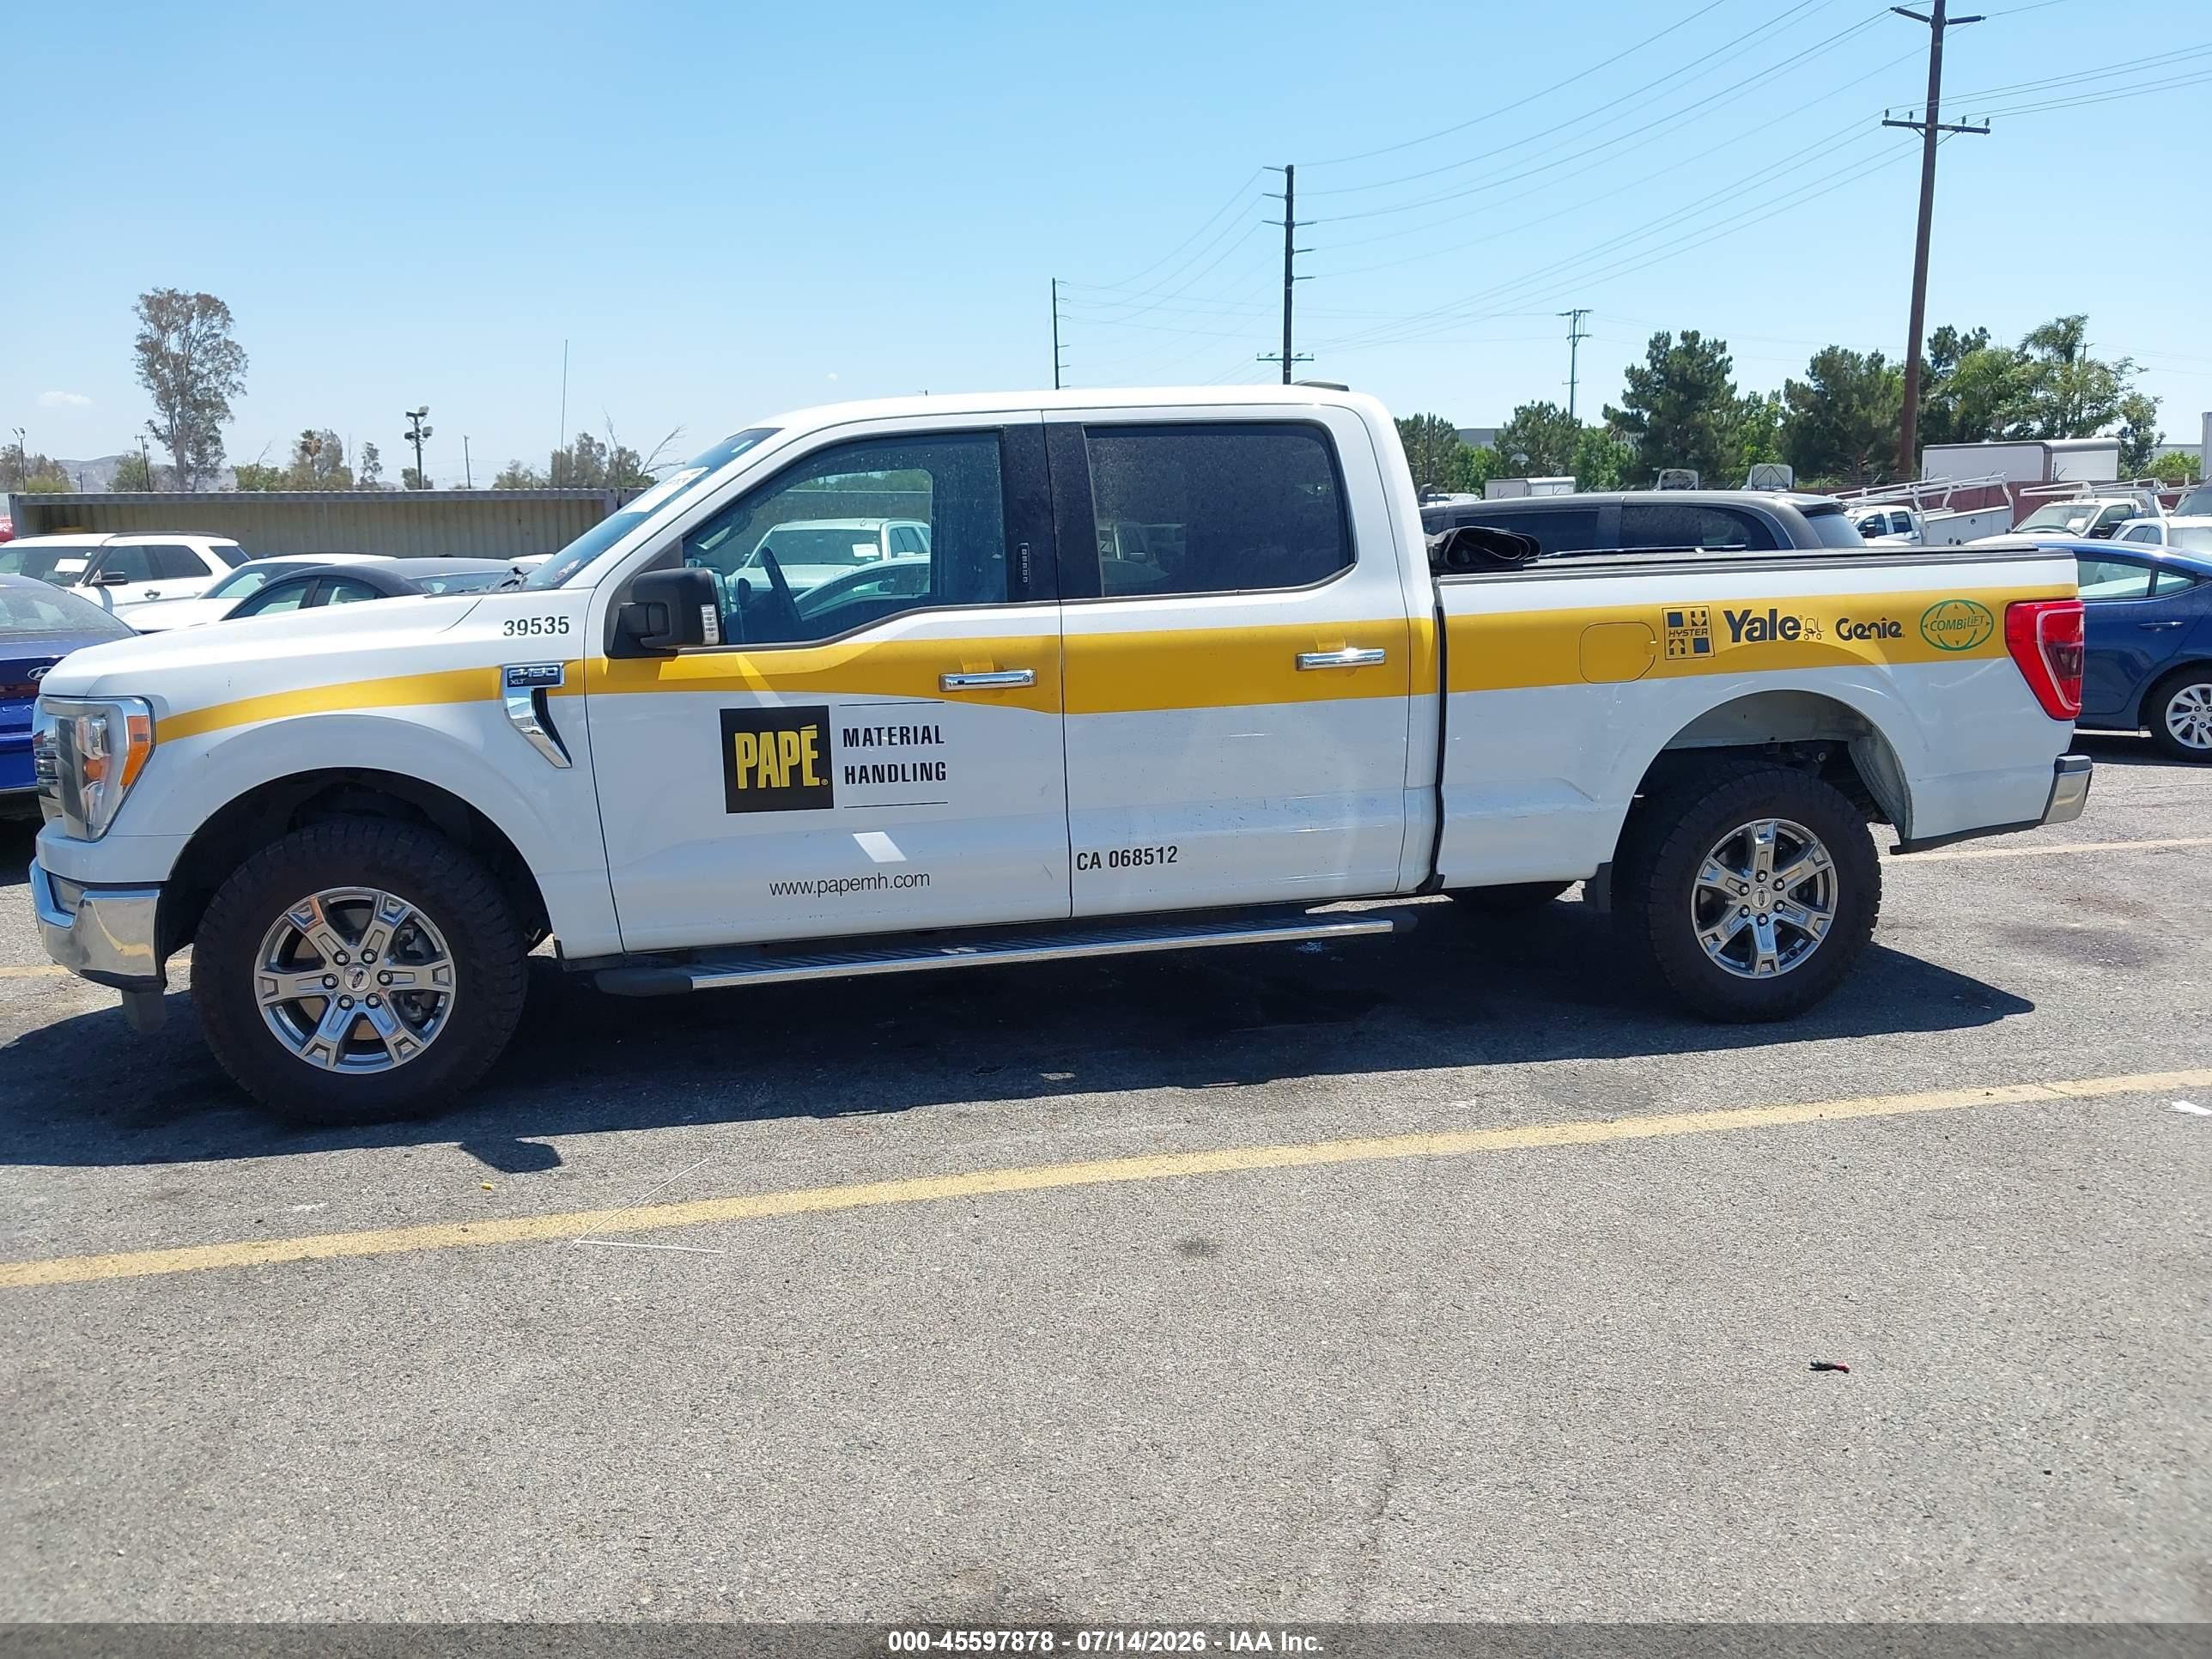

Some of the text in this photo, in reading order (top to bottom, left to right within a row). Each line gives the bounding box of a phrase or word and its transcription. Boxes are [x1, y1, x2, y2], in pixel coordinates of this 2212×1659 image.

[504, 616, 570, 637] 39535
[1668, 628, 1708, 638] HYSTER
[1723, 608, 1802, 643] Yale
[1835, 617, 1903, 641] Genie
[842, 725, 945, 748] MATERIAL
[844, 762, 948, 785] HANDLING
[1077, 845, 1178, 871] CA 068512
[769, 872, 930, 897] www.papemh.com
